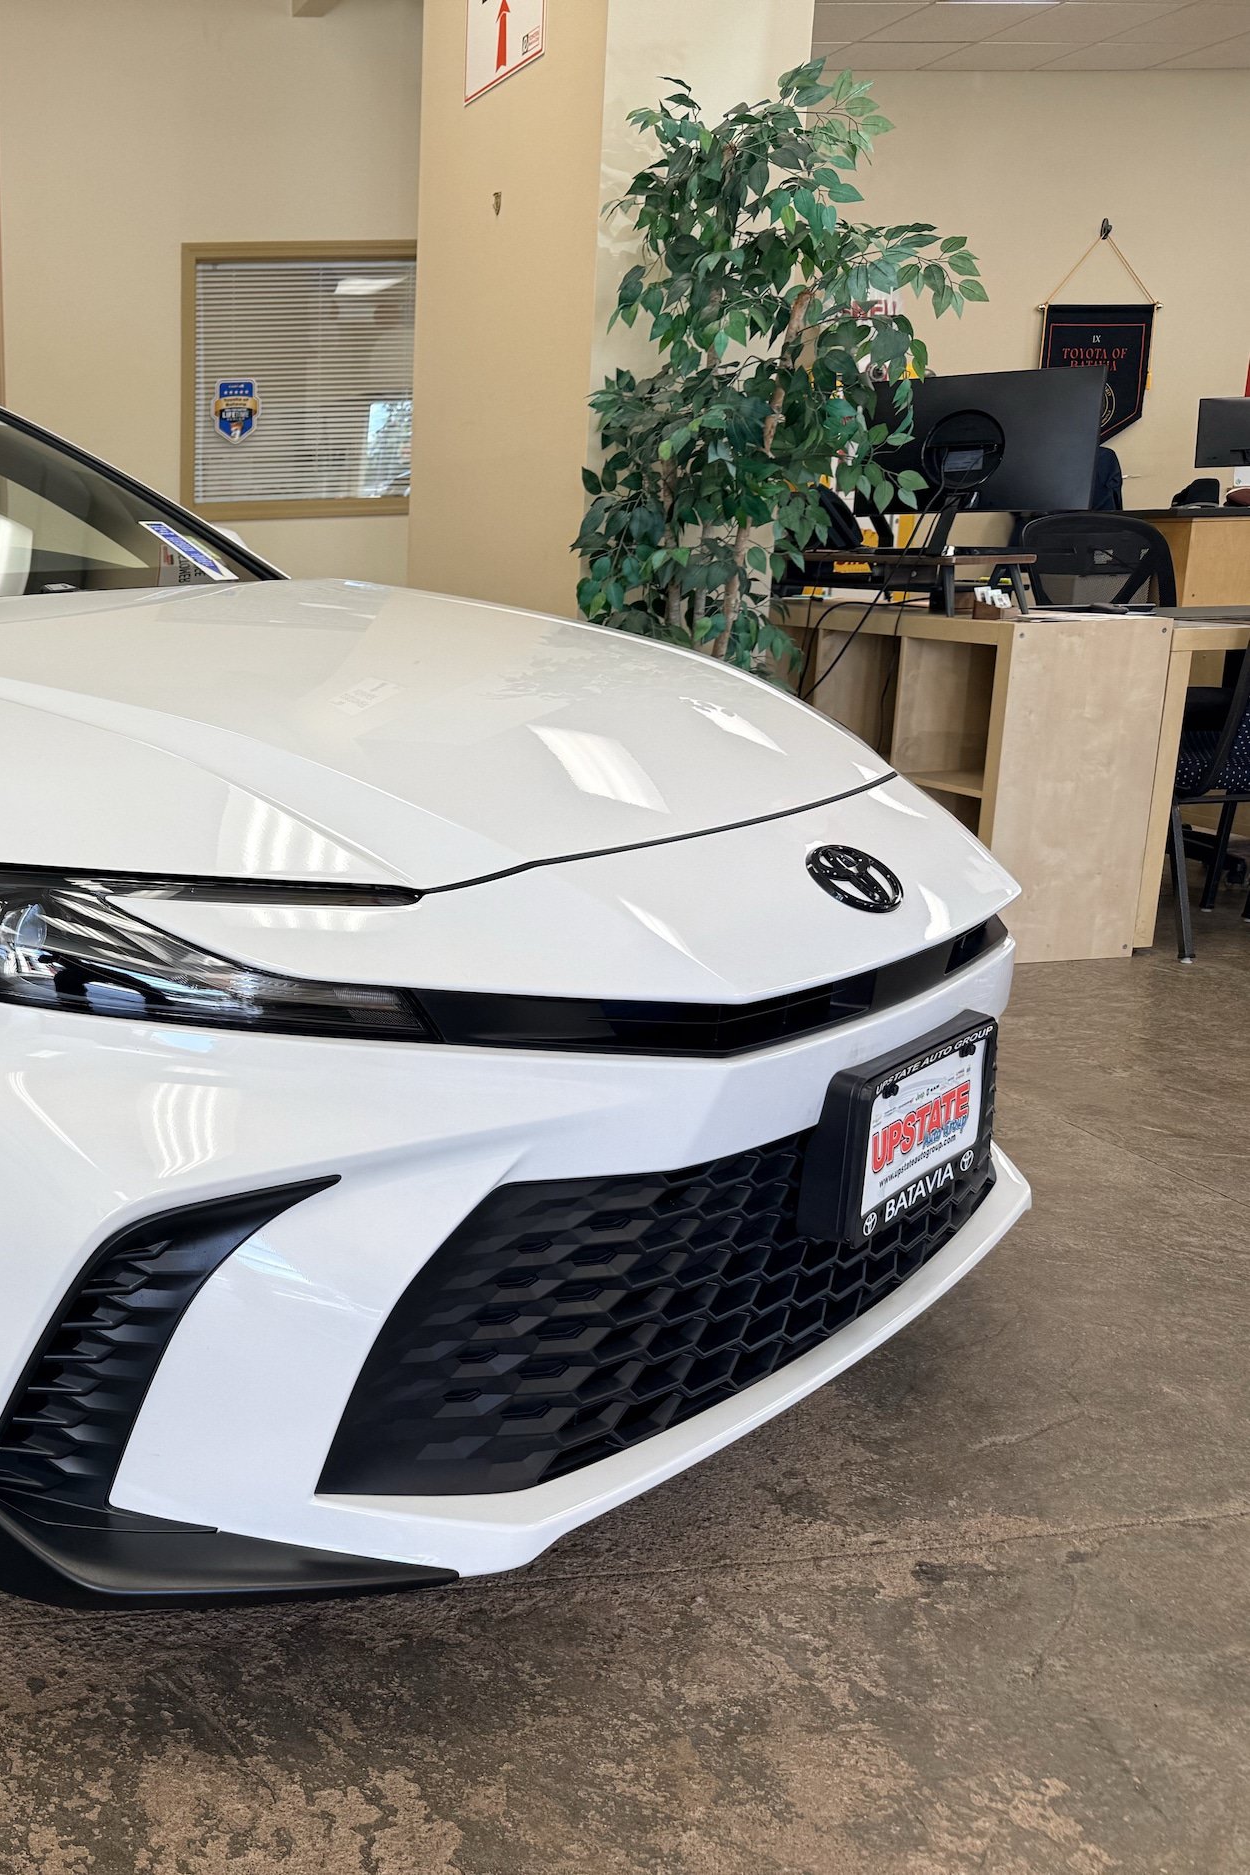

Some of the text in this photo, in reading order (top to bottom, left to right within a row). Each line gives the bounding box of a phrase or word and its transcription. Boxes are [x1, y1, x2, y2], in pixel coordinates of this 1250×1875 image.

[1062, 348, 1128, 359] TOYOTA OF
[875, 1060, 921, 1095] UPSTATE
[921, 1045, 953, 1067] AUTO
[954, 1025, 994, 1049] GROUP
[871, 1080, 970, 1174] UPSTATE
[879, 1134, 957, 1188] www.upstateautogroup.com
[884, 1162, 954, 1223] BATAVIA
